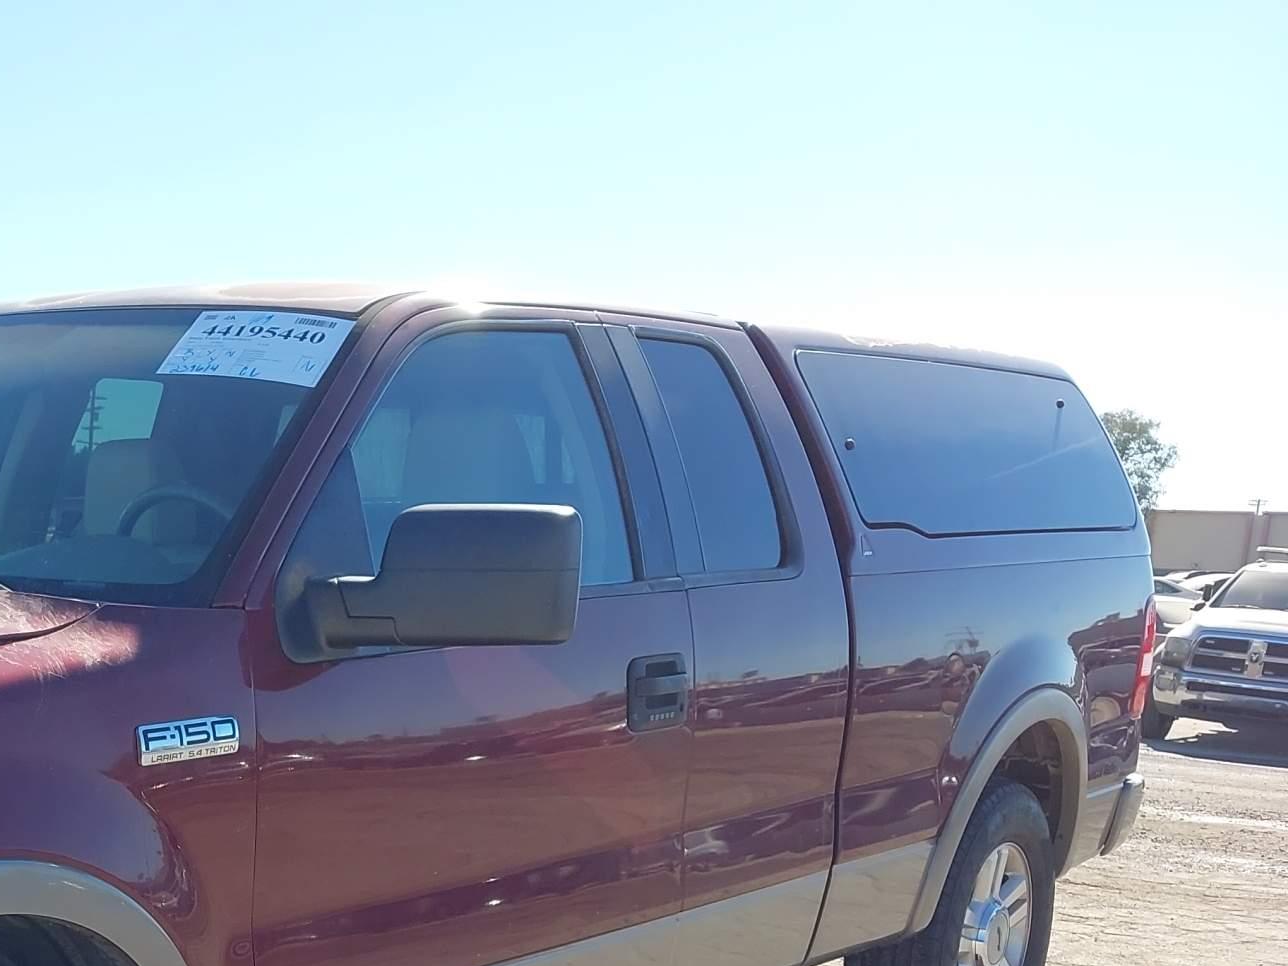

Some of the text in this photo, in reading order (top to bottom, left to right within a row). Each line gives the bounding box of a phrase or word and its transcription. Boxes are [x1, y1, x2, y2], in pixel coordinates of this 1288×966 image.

[201, 323, 327, 345] 44195440
[142, 718, 236, 752] F-150
[151, 744, 237, 763] LARIAT 5.4 TRITON
